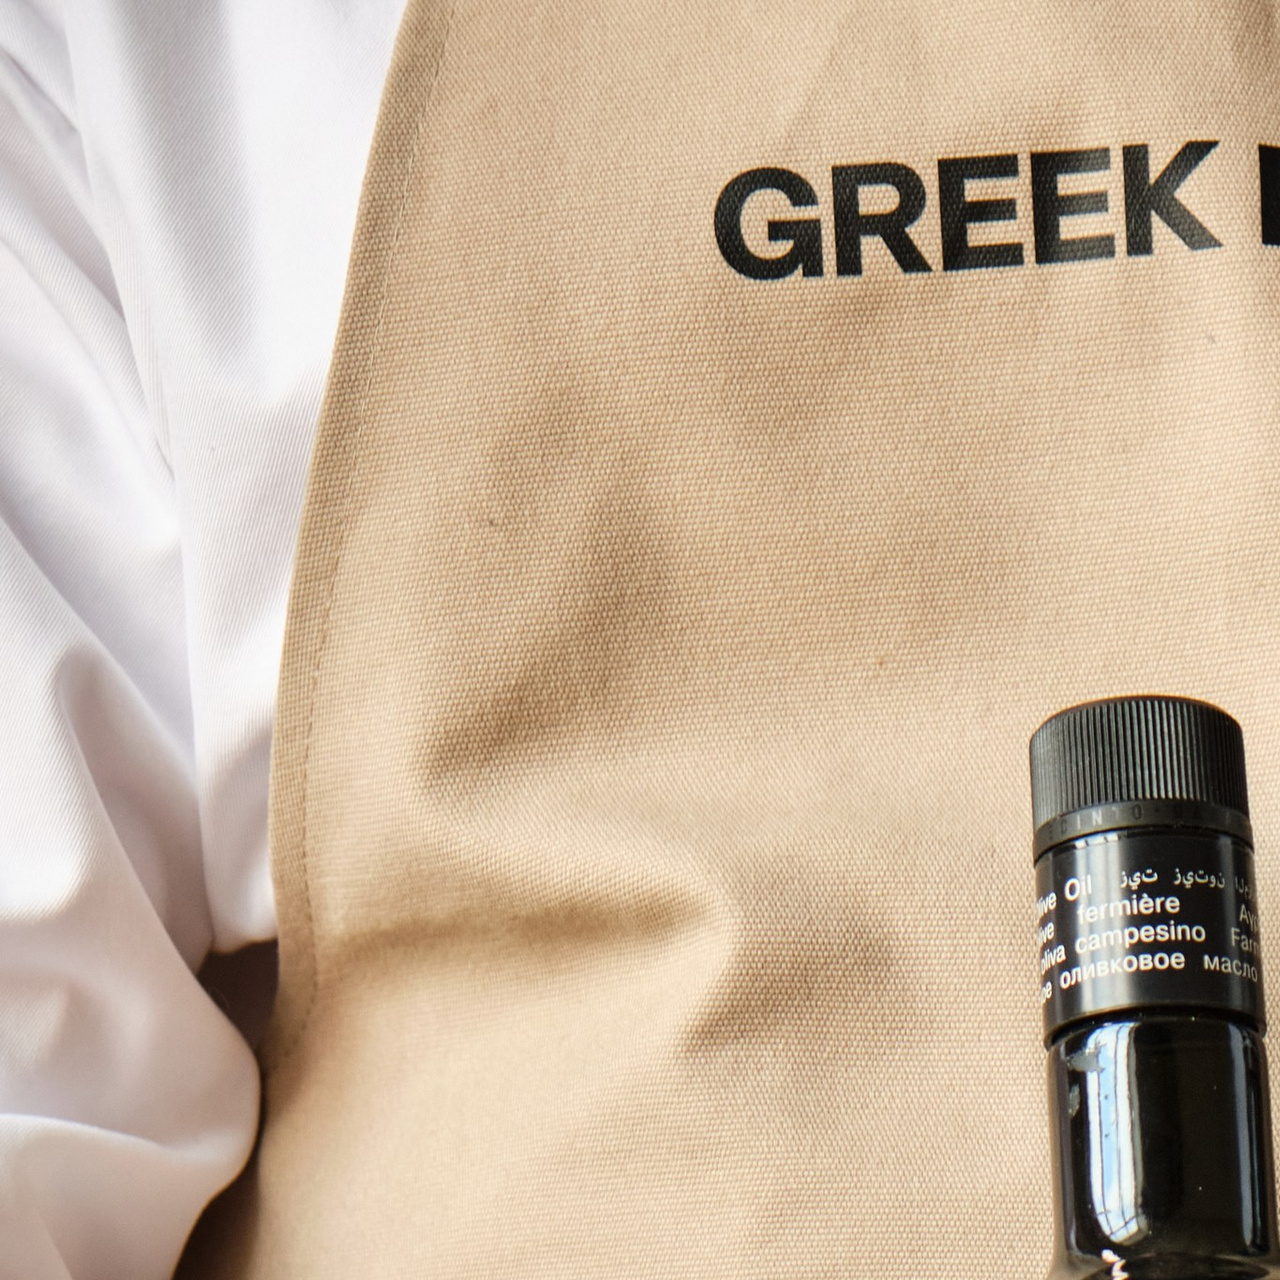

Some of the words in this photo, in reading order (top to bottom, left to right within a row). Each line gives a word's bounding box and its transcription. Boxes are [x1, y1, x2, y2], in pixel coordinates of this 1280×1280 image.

[713, 140, 1223, 281] GREEK
[1064, 874, 1093, 901] Oil
[1076, 893, 1181, 925] fermière
[1040, 944, 1067, 976] oliva
[1075, 920, 1206, 954] campesino
[1060, 952, 1185, 989] оливковое
[1203, 954, 1258, 982] масло
